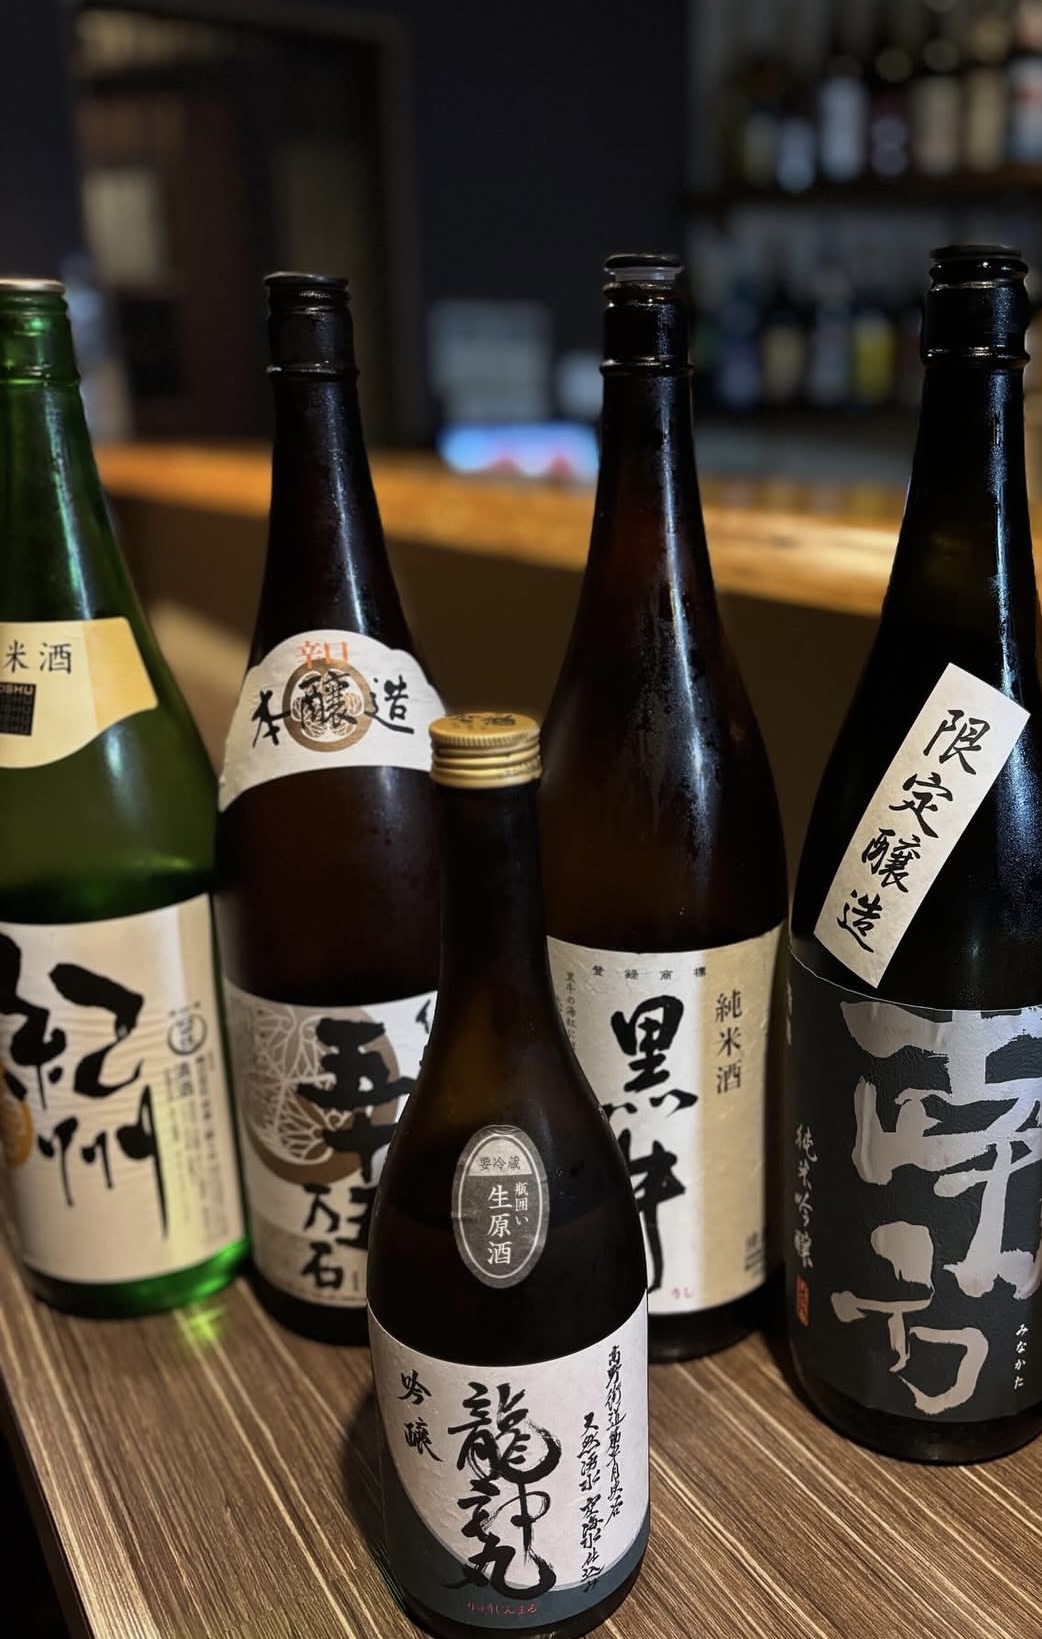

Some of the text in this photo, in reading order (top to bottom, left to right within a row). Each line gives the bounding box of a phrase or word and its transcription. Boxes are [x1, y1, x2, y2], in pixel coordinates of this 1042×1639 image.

[4, 639, 73, 675] 米酒
[297, 640, 349, 668] 辛口
[251, 670, 415, 748] 本醸造
[836, 709, 991, 953] 限定醸造
[714, 988, 744, 1095] 純米酒
[479, 1155, 521, 1171] 要冷蔵
[601, 994, 699, 1294] 黒牛
[487, 1184, 513, 1265] 生原酒
[515, 1181, 529, 1226] 瓶囲い
[1013, 1323, 1029, 1390] みなかた
[399, 1368, 443, 1463] 吟醸
[443, 1381, 562, 1600] 龍神丸
